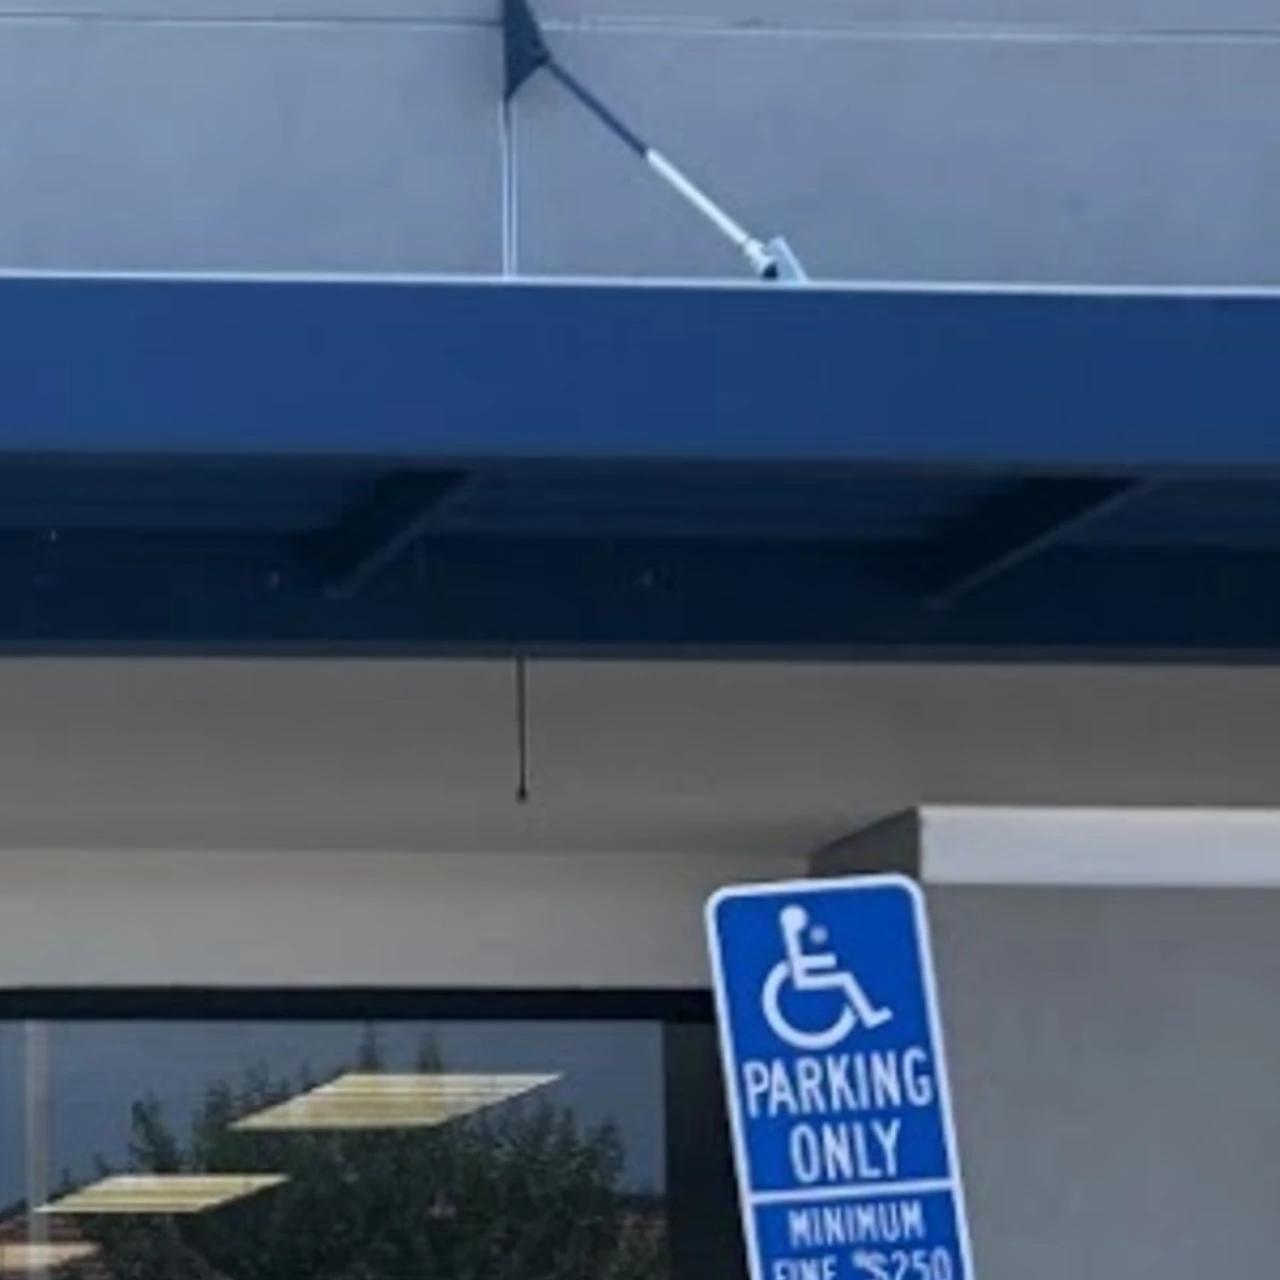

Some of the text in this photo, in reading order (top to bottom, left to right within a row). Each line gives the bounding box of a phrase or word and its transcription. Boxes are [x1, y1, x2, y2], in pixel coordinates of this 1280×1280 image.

[743, 1046, 934, 1118] PARKING
[791, 1116, 902, 1183] ONLY
[789, 1200, 925, 1249] MINIMUM
